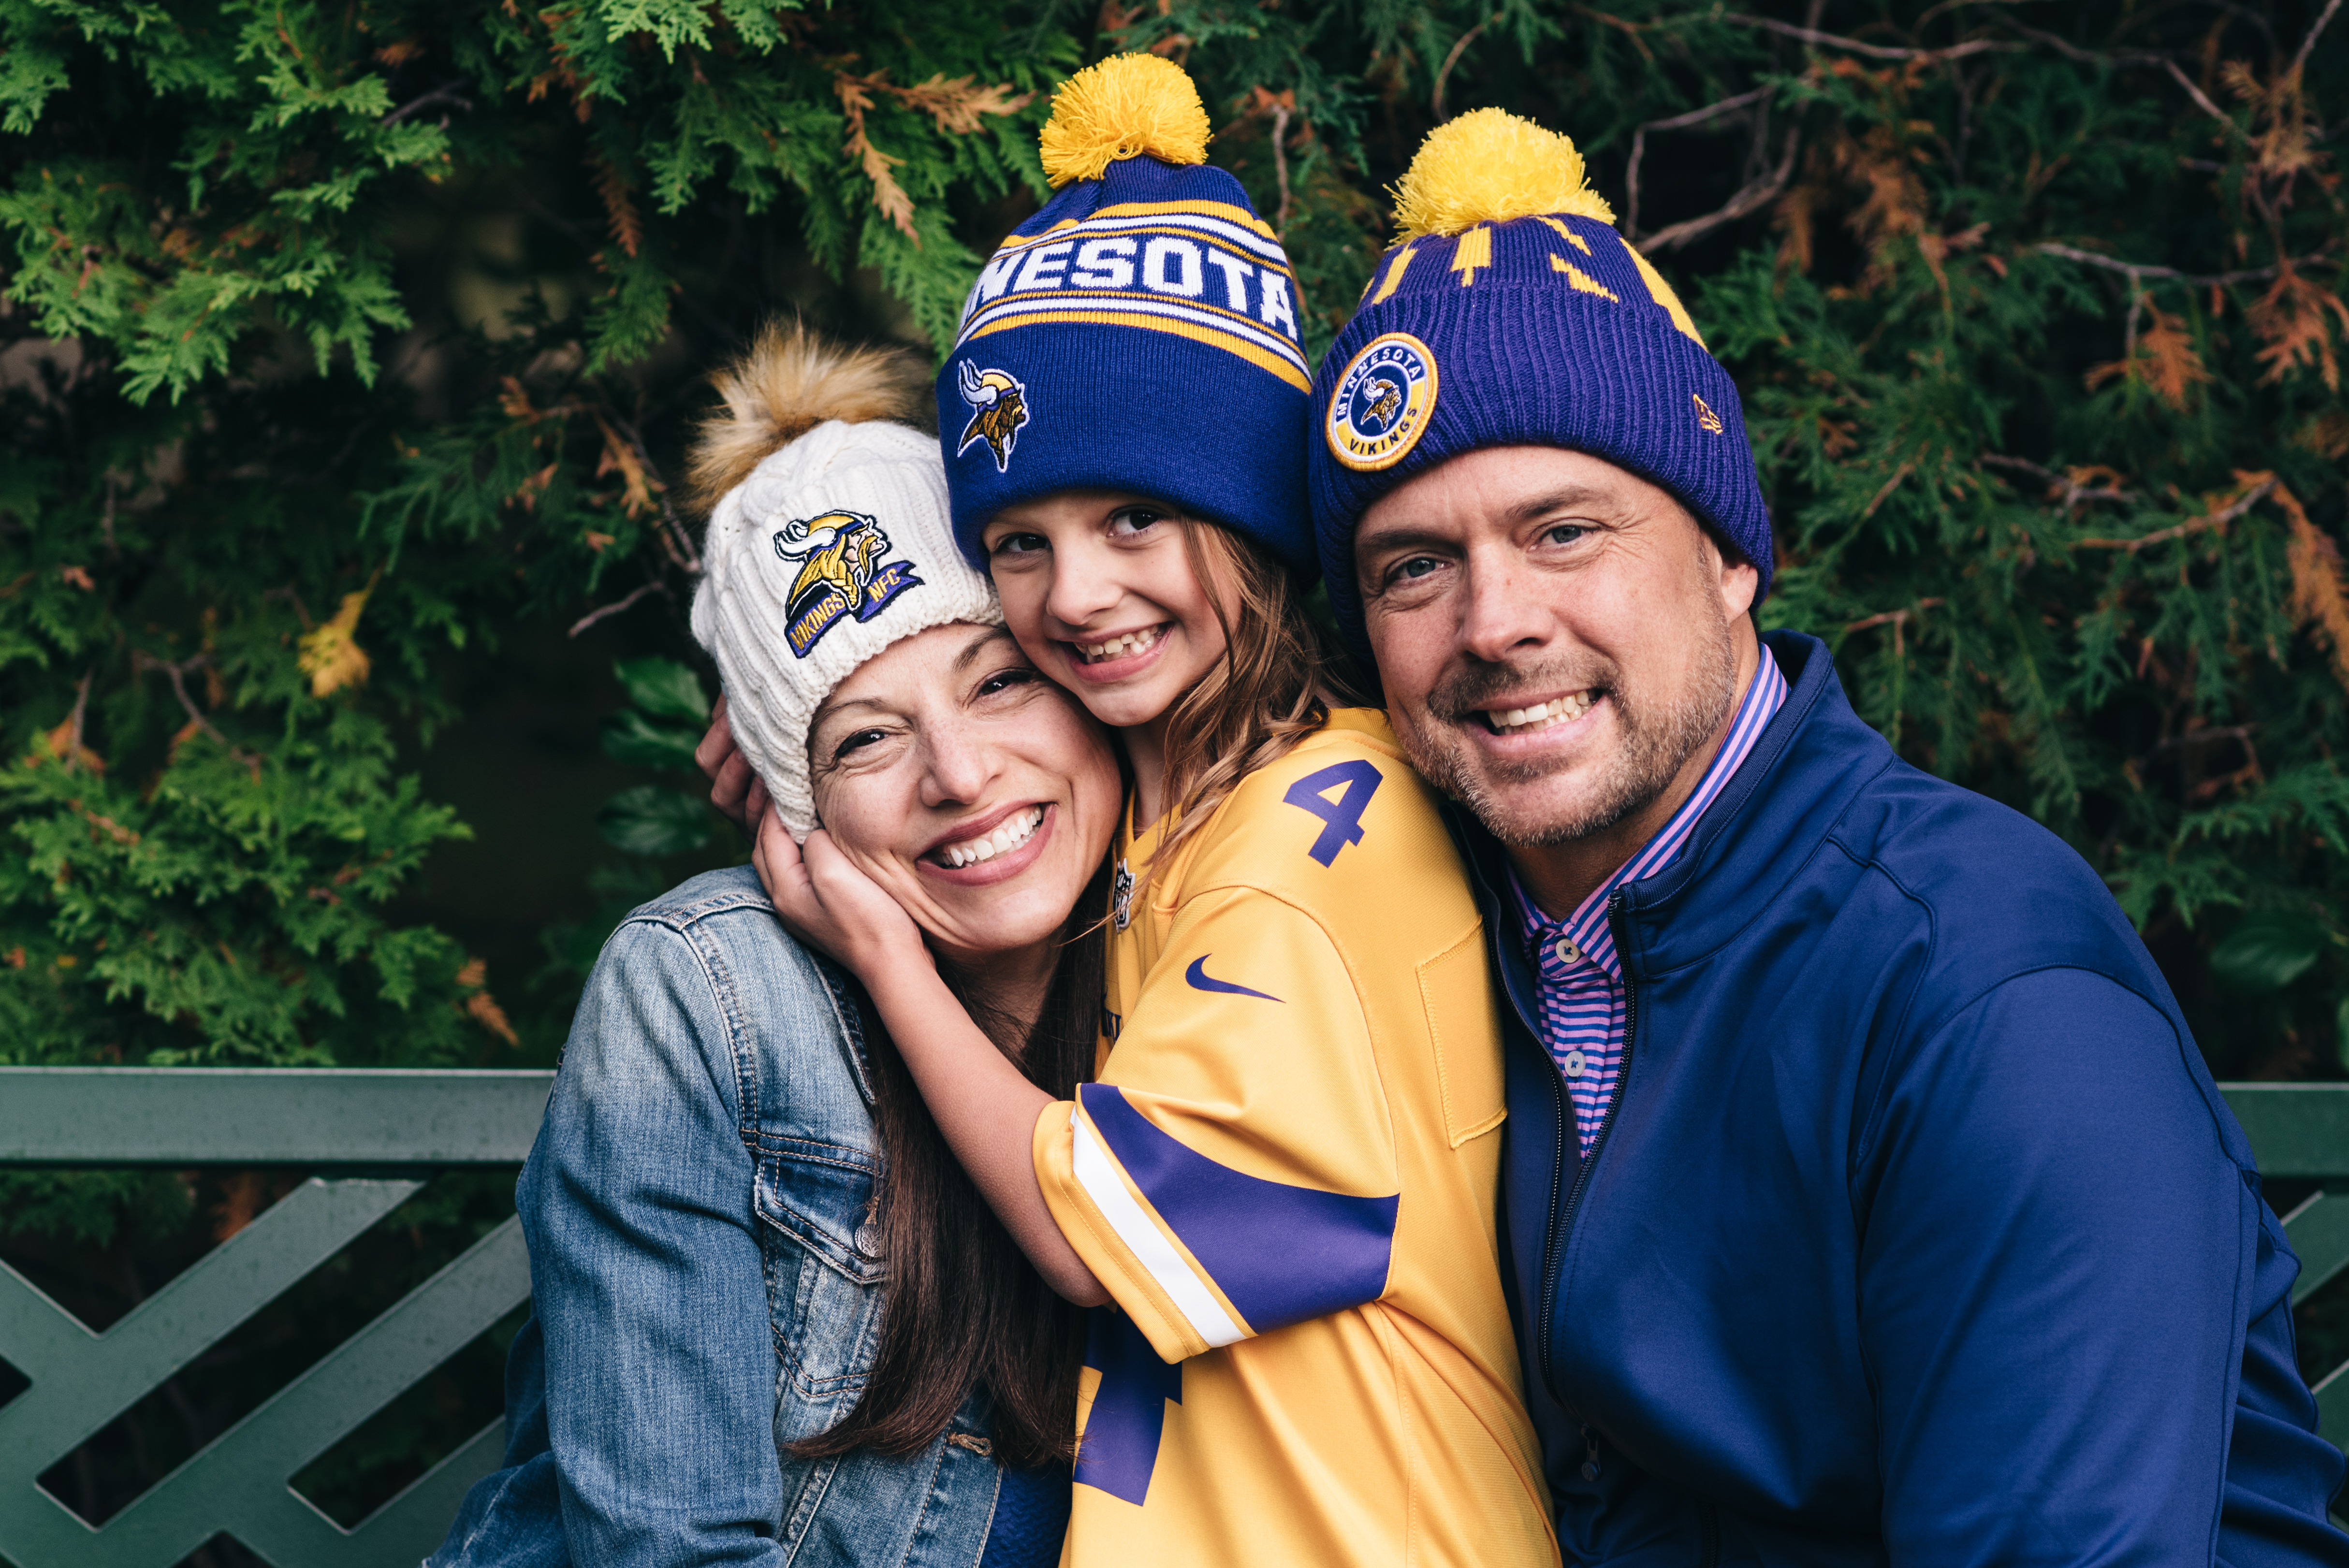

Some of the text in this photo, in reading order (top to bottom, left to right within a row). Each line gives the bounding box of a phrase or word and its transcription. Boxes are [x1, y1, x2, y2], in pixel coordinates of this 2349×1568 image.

[1337, 348, 1421, 416] MINNESOTA
[1350, 407, 1417, 455] VIKINGS
[789, 568, 901, 650] VIKINGS NFC
[1283, 759, 1383, 868] 4
